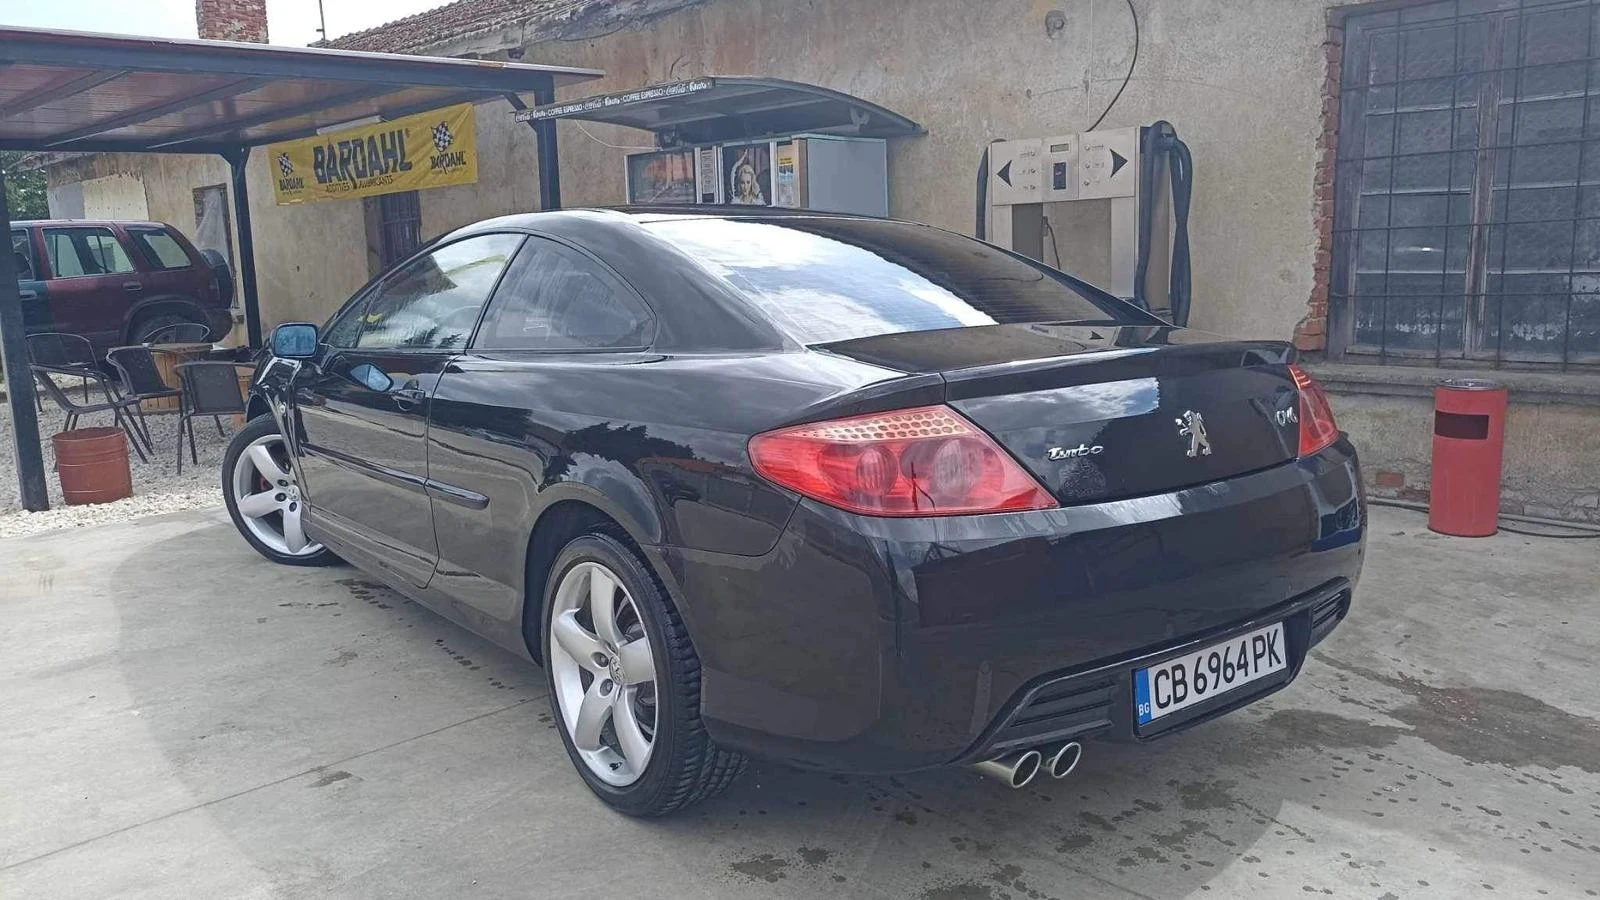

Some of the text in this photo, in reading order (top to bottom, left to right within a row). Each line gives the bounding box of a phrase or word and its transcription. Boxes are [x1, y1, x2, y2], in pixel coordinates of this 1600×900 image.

[548, 106, 562, 116] COFFEE
[563, 104, 582, 113] ESPRESSO
[623, 93, 640, 102] COFFEE
[640, 88, 663, 99] ESPRESSO
[313, 129, 413, 188] BARDAHL
[430, 151, 467, 173] BARDAHL
[279, 177, 304, 192] BARDAHL
[1048, 444, 1103, 460] Turbo
[1154, 628, 1282, 709] CB 6964 PK
[1138, 702, 1150, 716] BG
